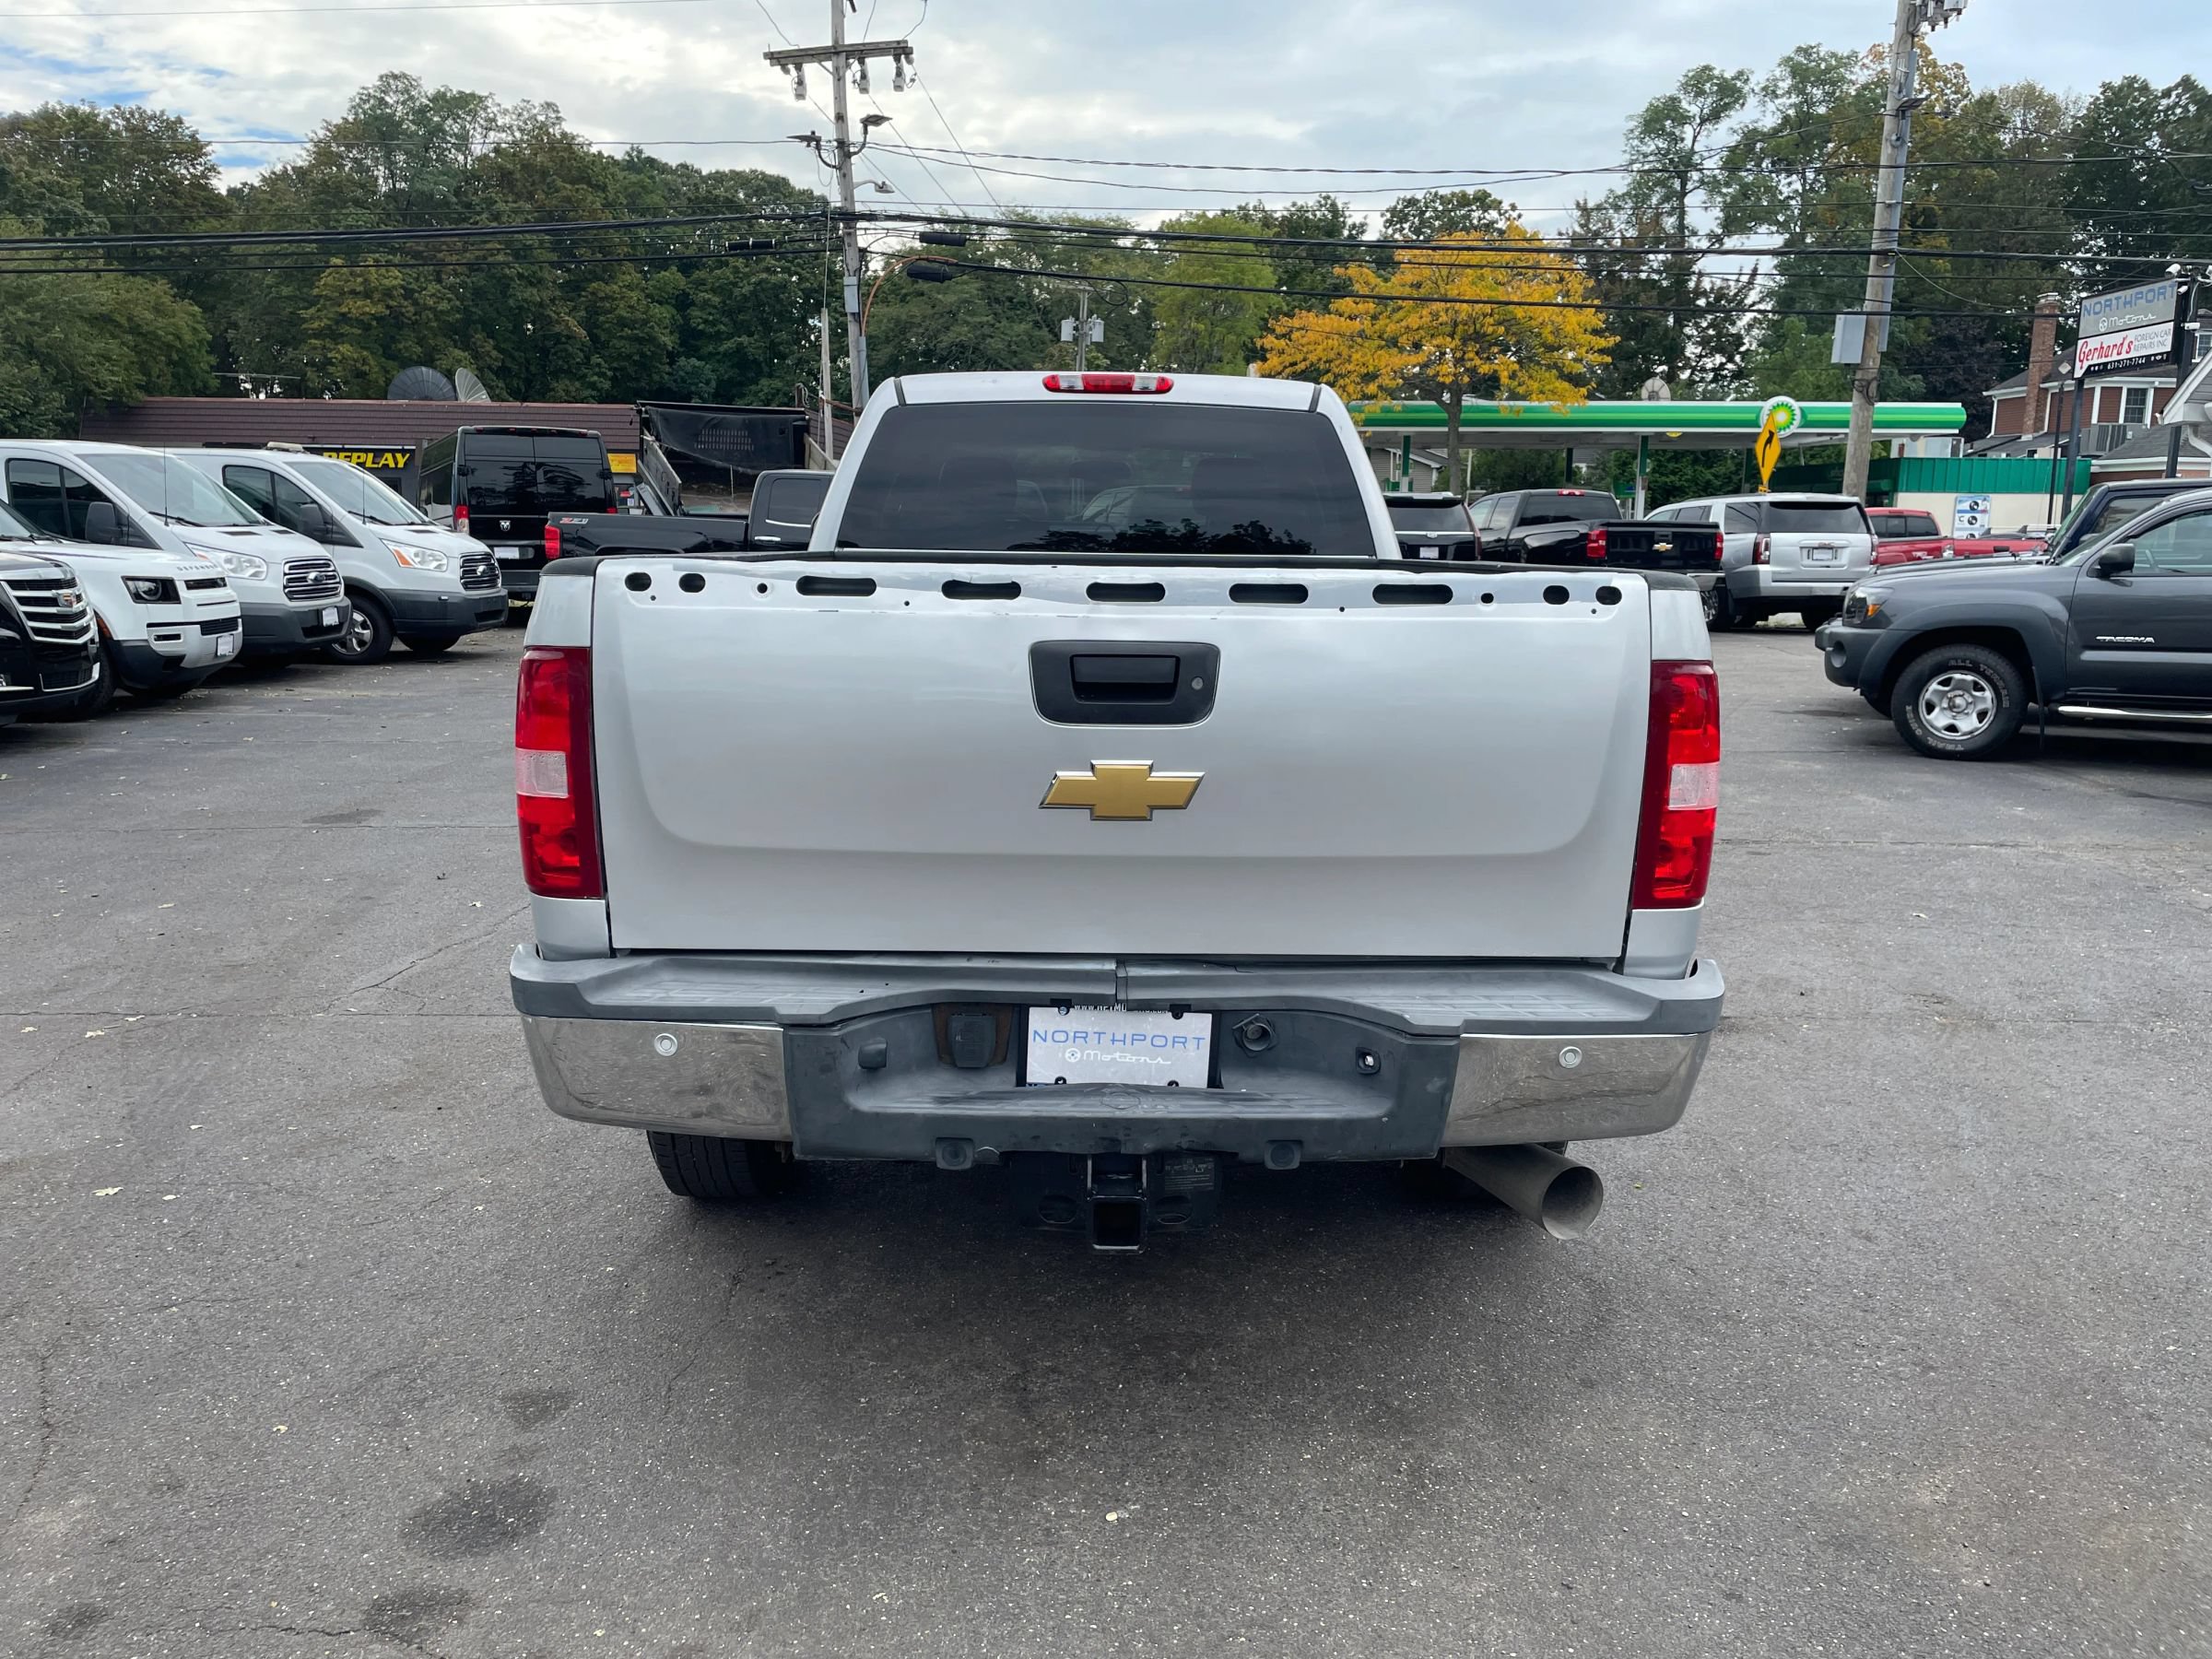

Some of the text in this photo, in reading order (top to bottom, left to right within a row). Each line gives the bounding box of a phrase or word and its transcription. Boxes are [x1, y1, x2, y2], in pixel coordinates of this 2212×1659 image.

[2083, 281, 2177, 317] NORTHPORT
[2108, 313, 2157, 328] Motors
[2078, 335, 2134, 370] Gerhard's
[1948, 659, 1972, 667] ALL
[1033, 1030, 1206, 1051] NORTHPORT
[1083, 1050, 1171, 1065] Motors
